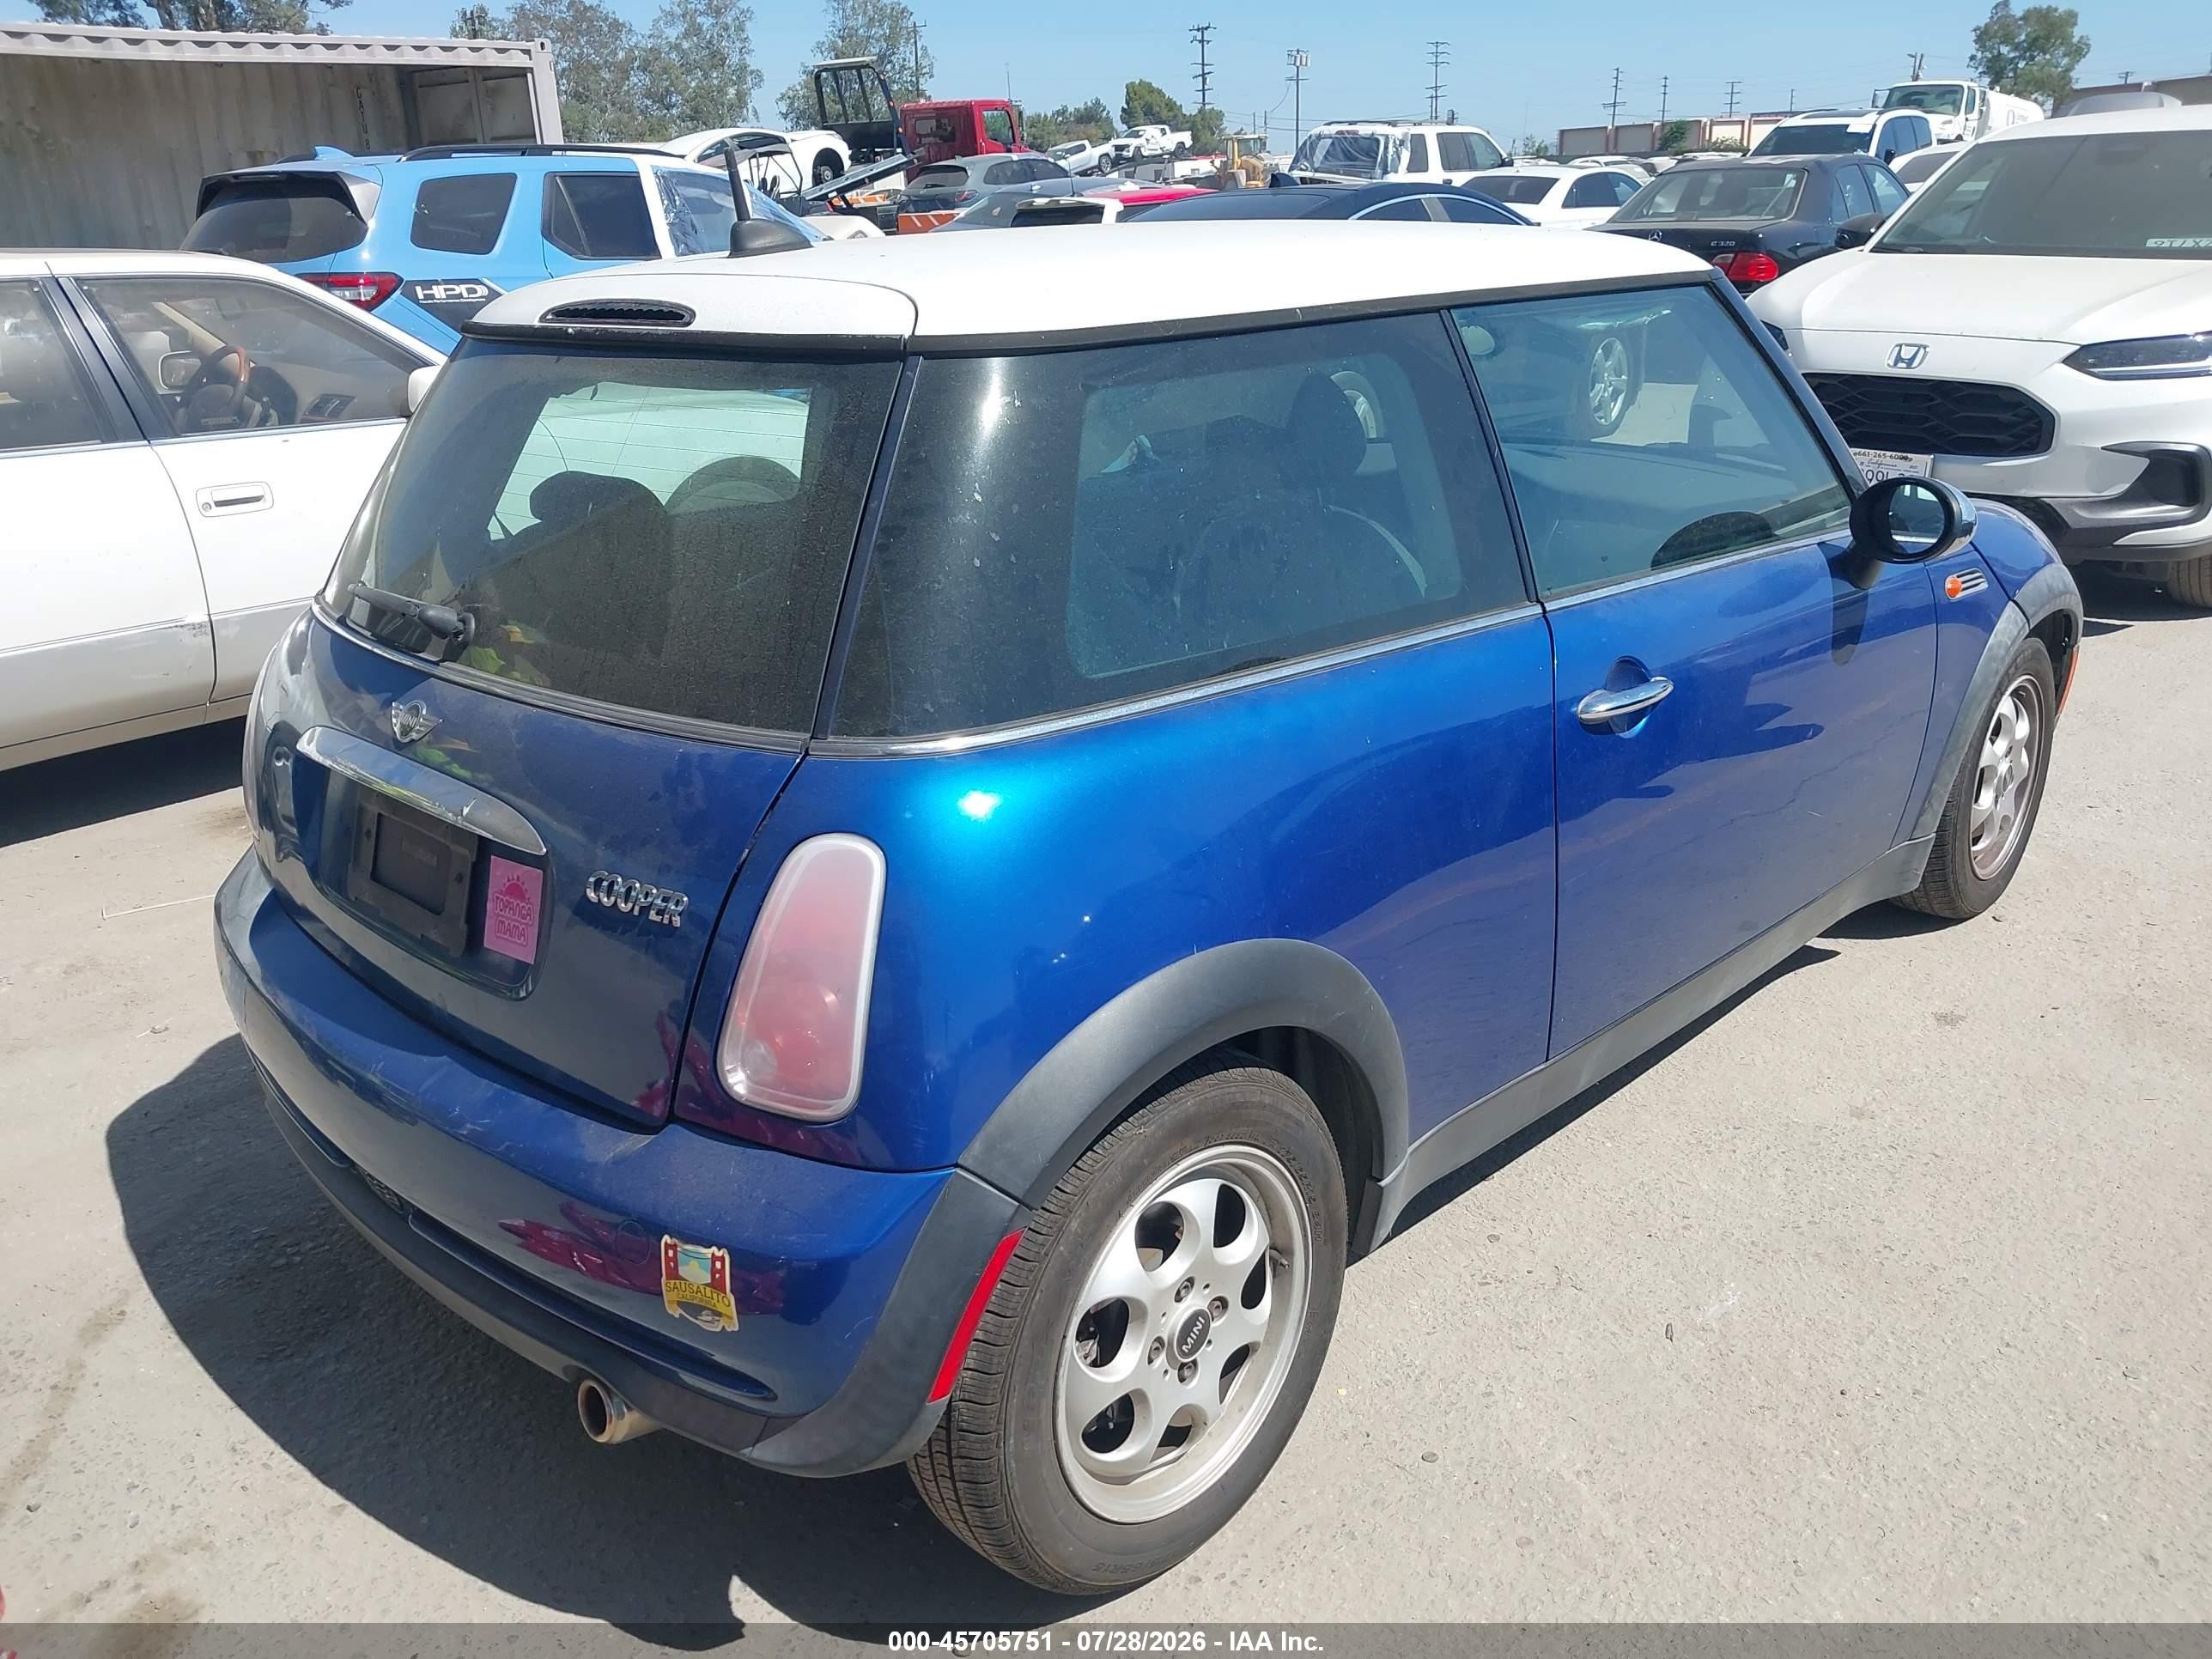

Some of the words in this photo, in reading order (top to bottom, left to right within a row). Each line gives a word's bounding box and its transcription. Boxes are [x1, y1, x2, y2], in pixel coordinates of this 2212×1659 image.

[415, 284, 489, 300] HPD
[494, 893, 533, 923] TOPANGA
[586, 870, 689, 927] COOPER
[496, 918, 527, 944] MAMA
[665, 1282, 730, 1306] SAUSALITO
[1182, 1316, 1206, 1353] MINI
